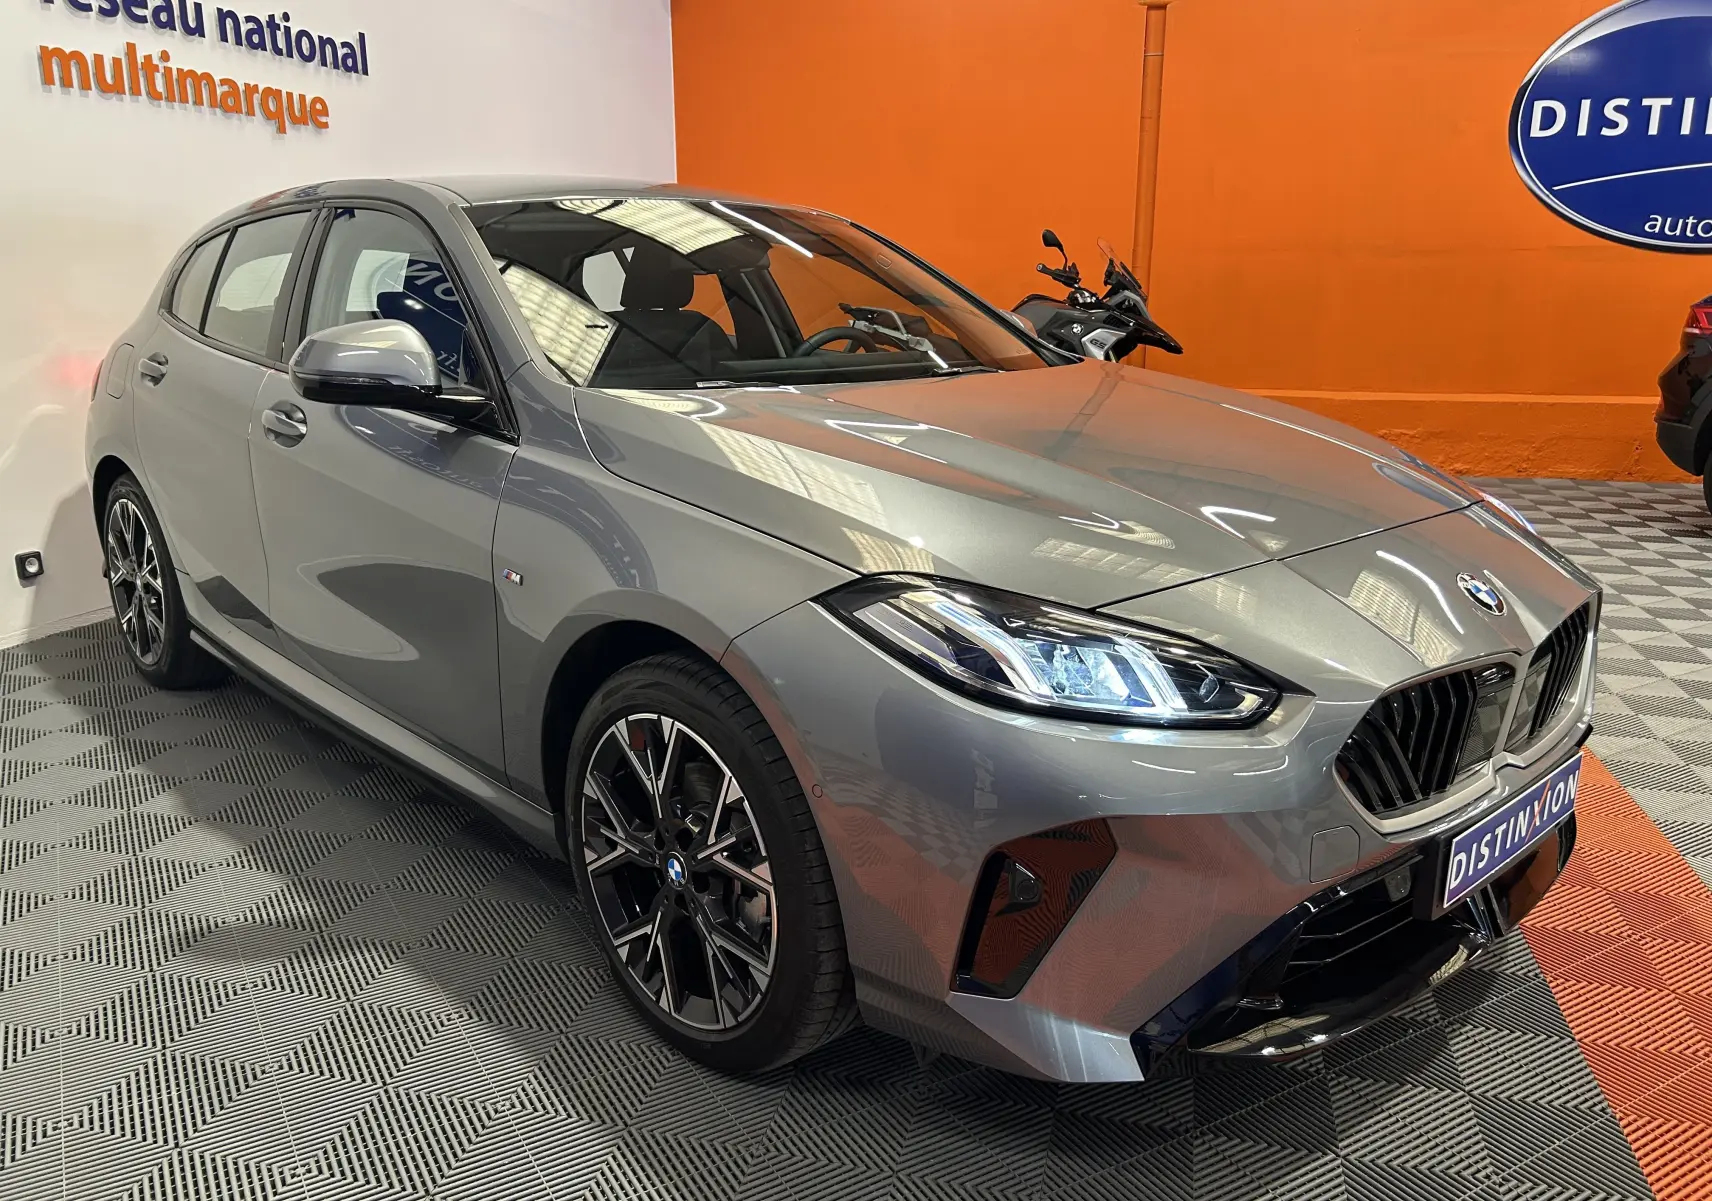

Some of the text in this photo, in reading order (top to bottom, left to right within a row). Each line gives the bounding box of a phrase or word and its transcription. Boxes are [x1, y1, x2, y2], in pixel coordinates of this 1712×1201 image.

[41, 0, 369, 76] seau national
[39, 42, 329, 134] multimarque
[1529, 97, 1712, 138] DISTI
[1450, 769, 1579, 890] DISTINXION
